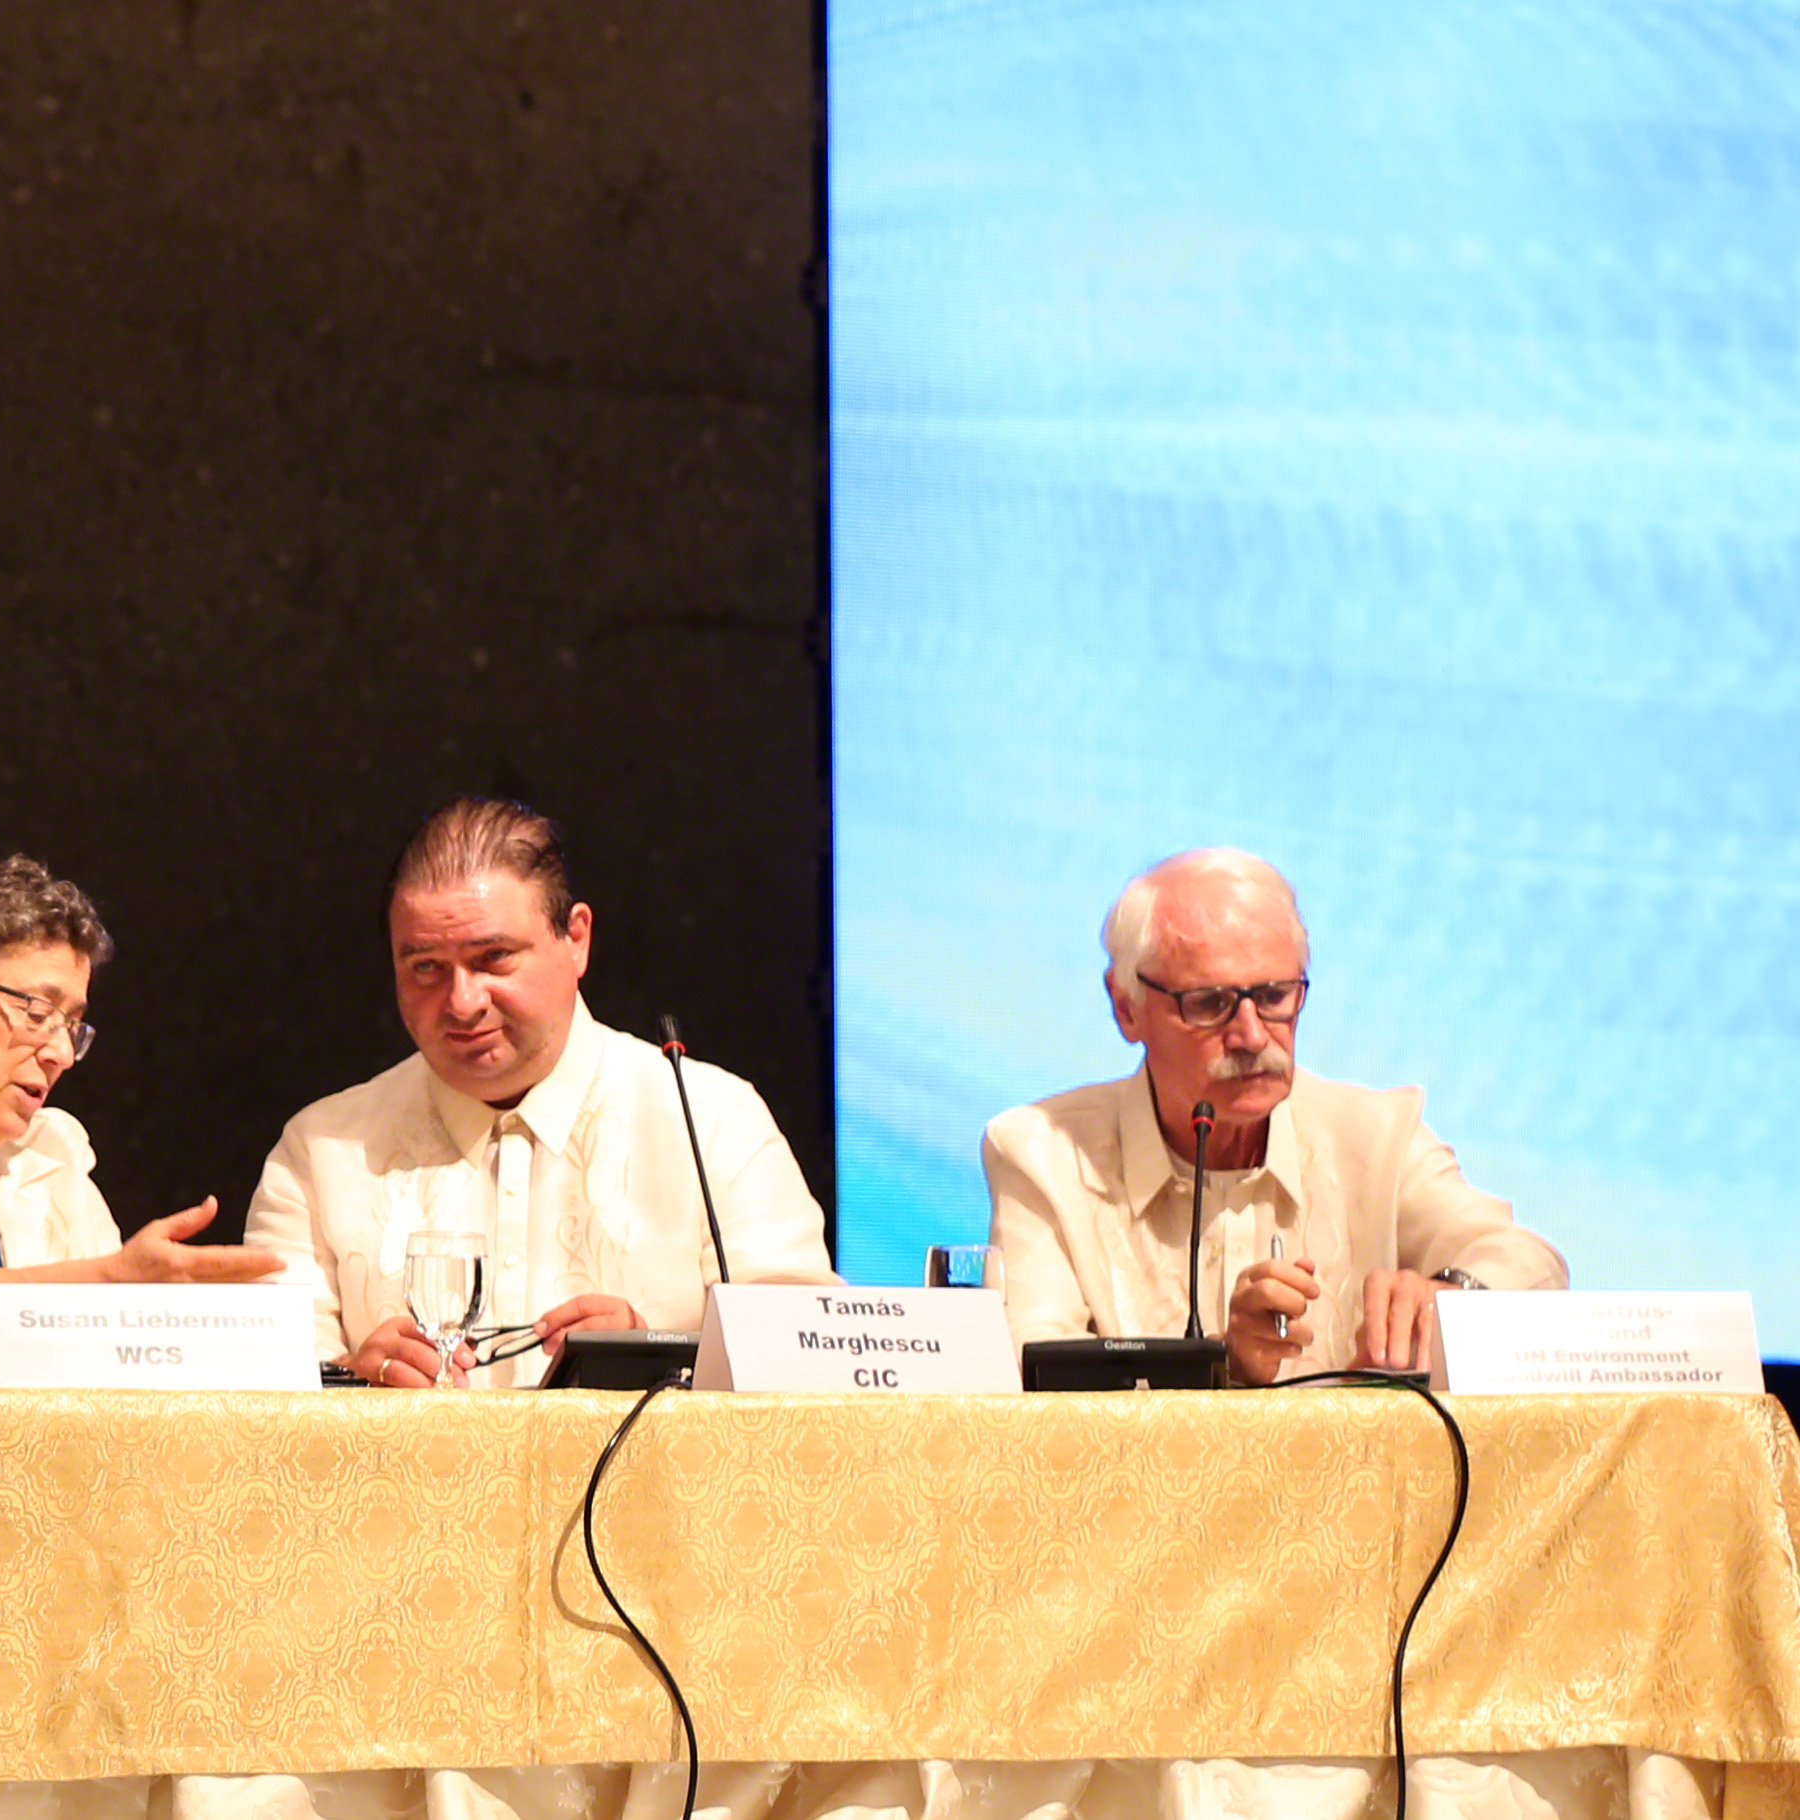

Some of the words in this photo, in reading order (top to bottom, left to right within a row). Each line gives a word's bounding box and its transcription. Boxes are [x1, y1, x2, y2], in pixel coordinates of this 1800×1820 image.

[816, 1296, 905, 1317] Tamás
[18, 1309, 108, 1329] Susan
[119, 1309, 275, 1329] Lieberman
[798, 1330, 941, 1355] Marghescu
[115, 1345, 183, 1365] WCS
[1554, 1350, 1691, 1364] Environment
[853, 1368, 899, 1389] CIC
[1589, 1368, 1723, 1384] Ambassador
